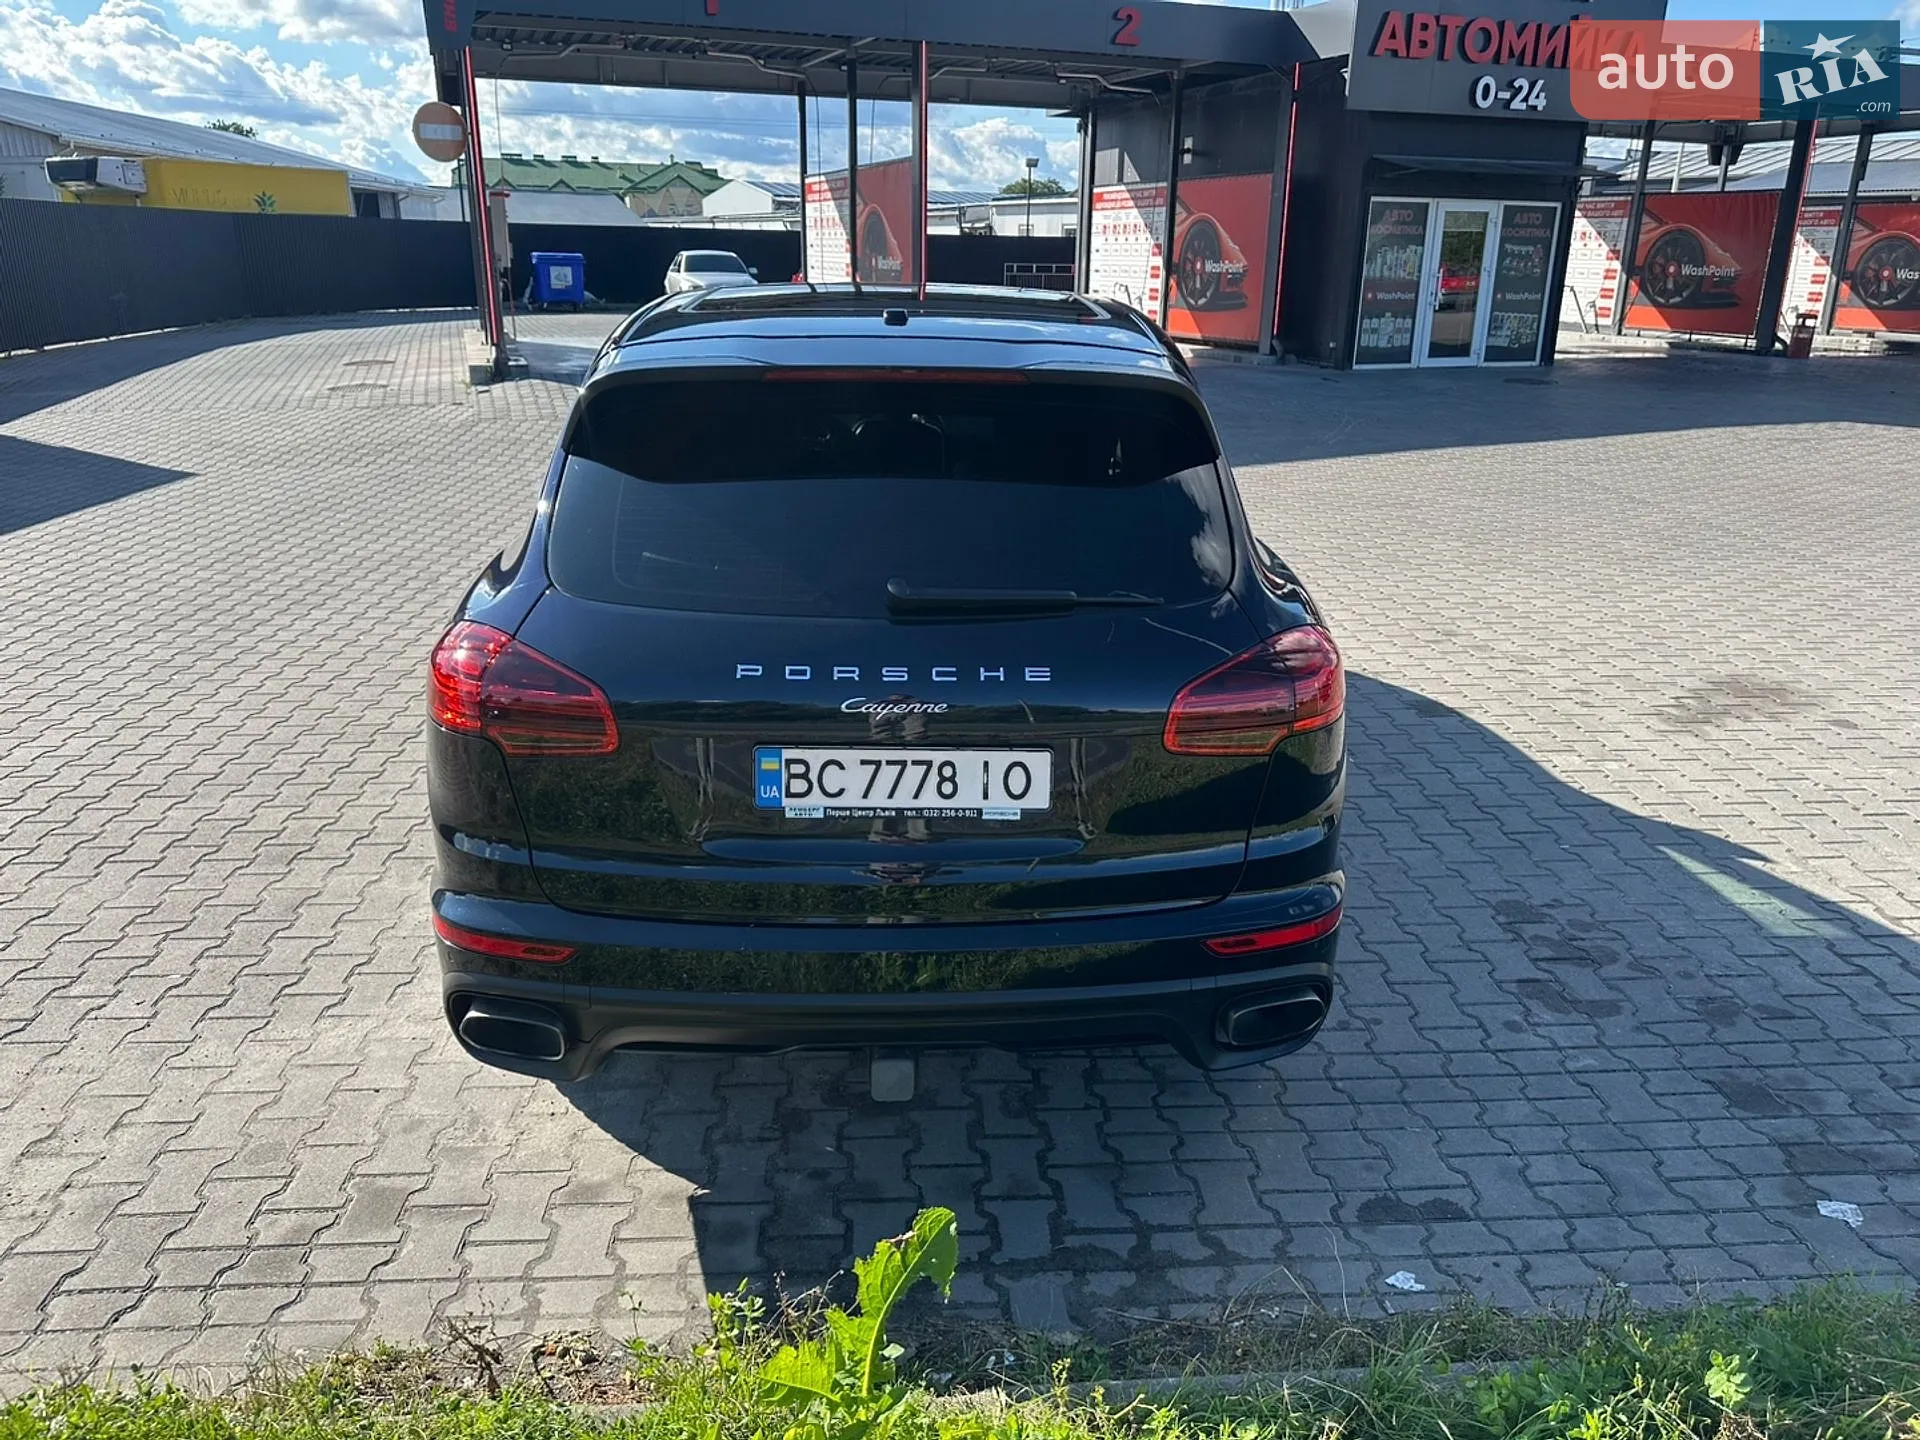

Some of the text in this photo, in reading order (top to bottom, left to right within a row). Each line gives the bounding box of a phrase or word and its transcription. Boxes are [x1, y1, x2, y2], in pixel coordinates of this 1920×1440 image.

[1113, 6, 1142, 46] 2
[1475, 75, 1547, 111] 0-24
[1383, 209, 1414, 222] АВТО
[1513, 212, 1542, 224] АВТО
[1370, 224, 1423, 236] КОСМЕТИКА
[1204, 259, 1243, 273] WashPoint
[1681, 263, 1735, 278] WashPoint
[1376, 291, 1416, 300] WashPoint
[1505, 291, 1541, 300] WashPoint
[736, 664, 1051, 682] PORSCHE
[840, 697, 948, 719] Cayenne
[784, 758, 846, 799] BC
[859, 759, 958, 800] 7778
[761, 785, 780, 798] UA
[941, 810, 978, 818] 256-0-911
